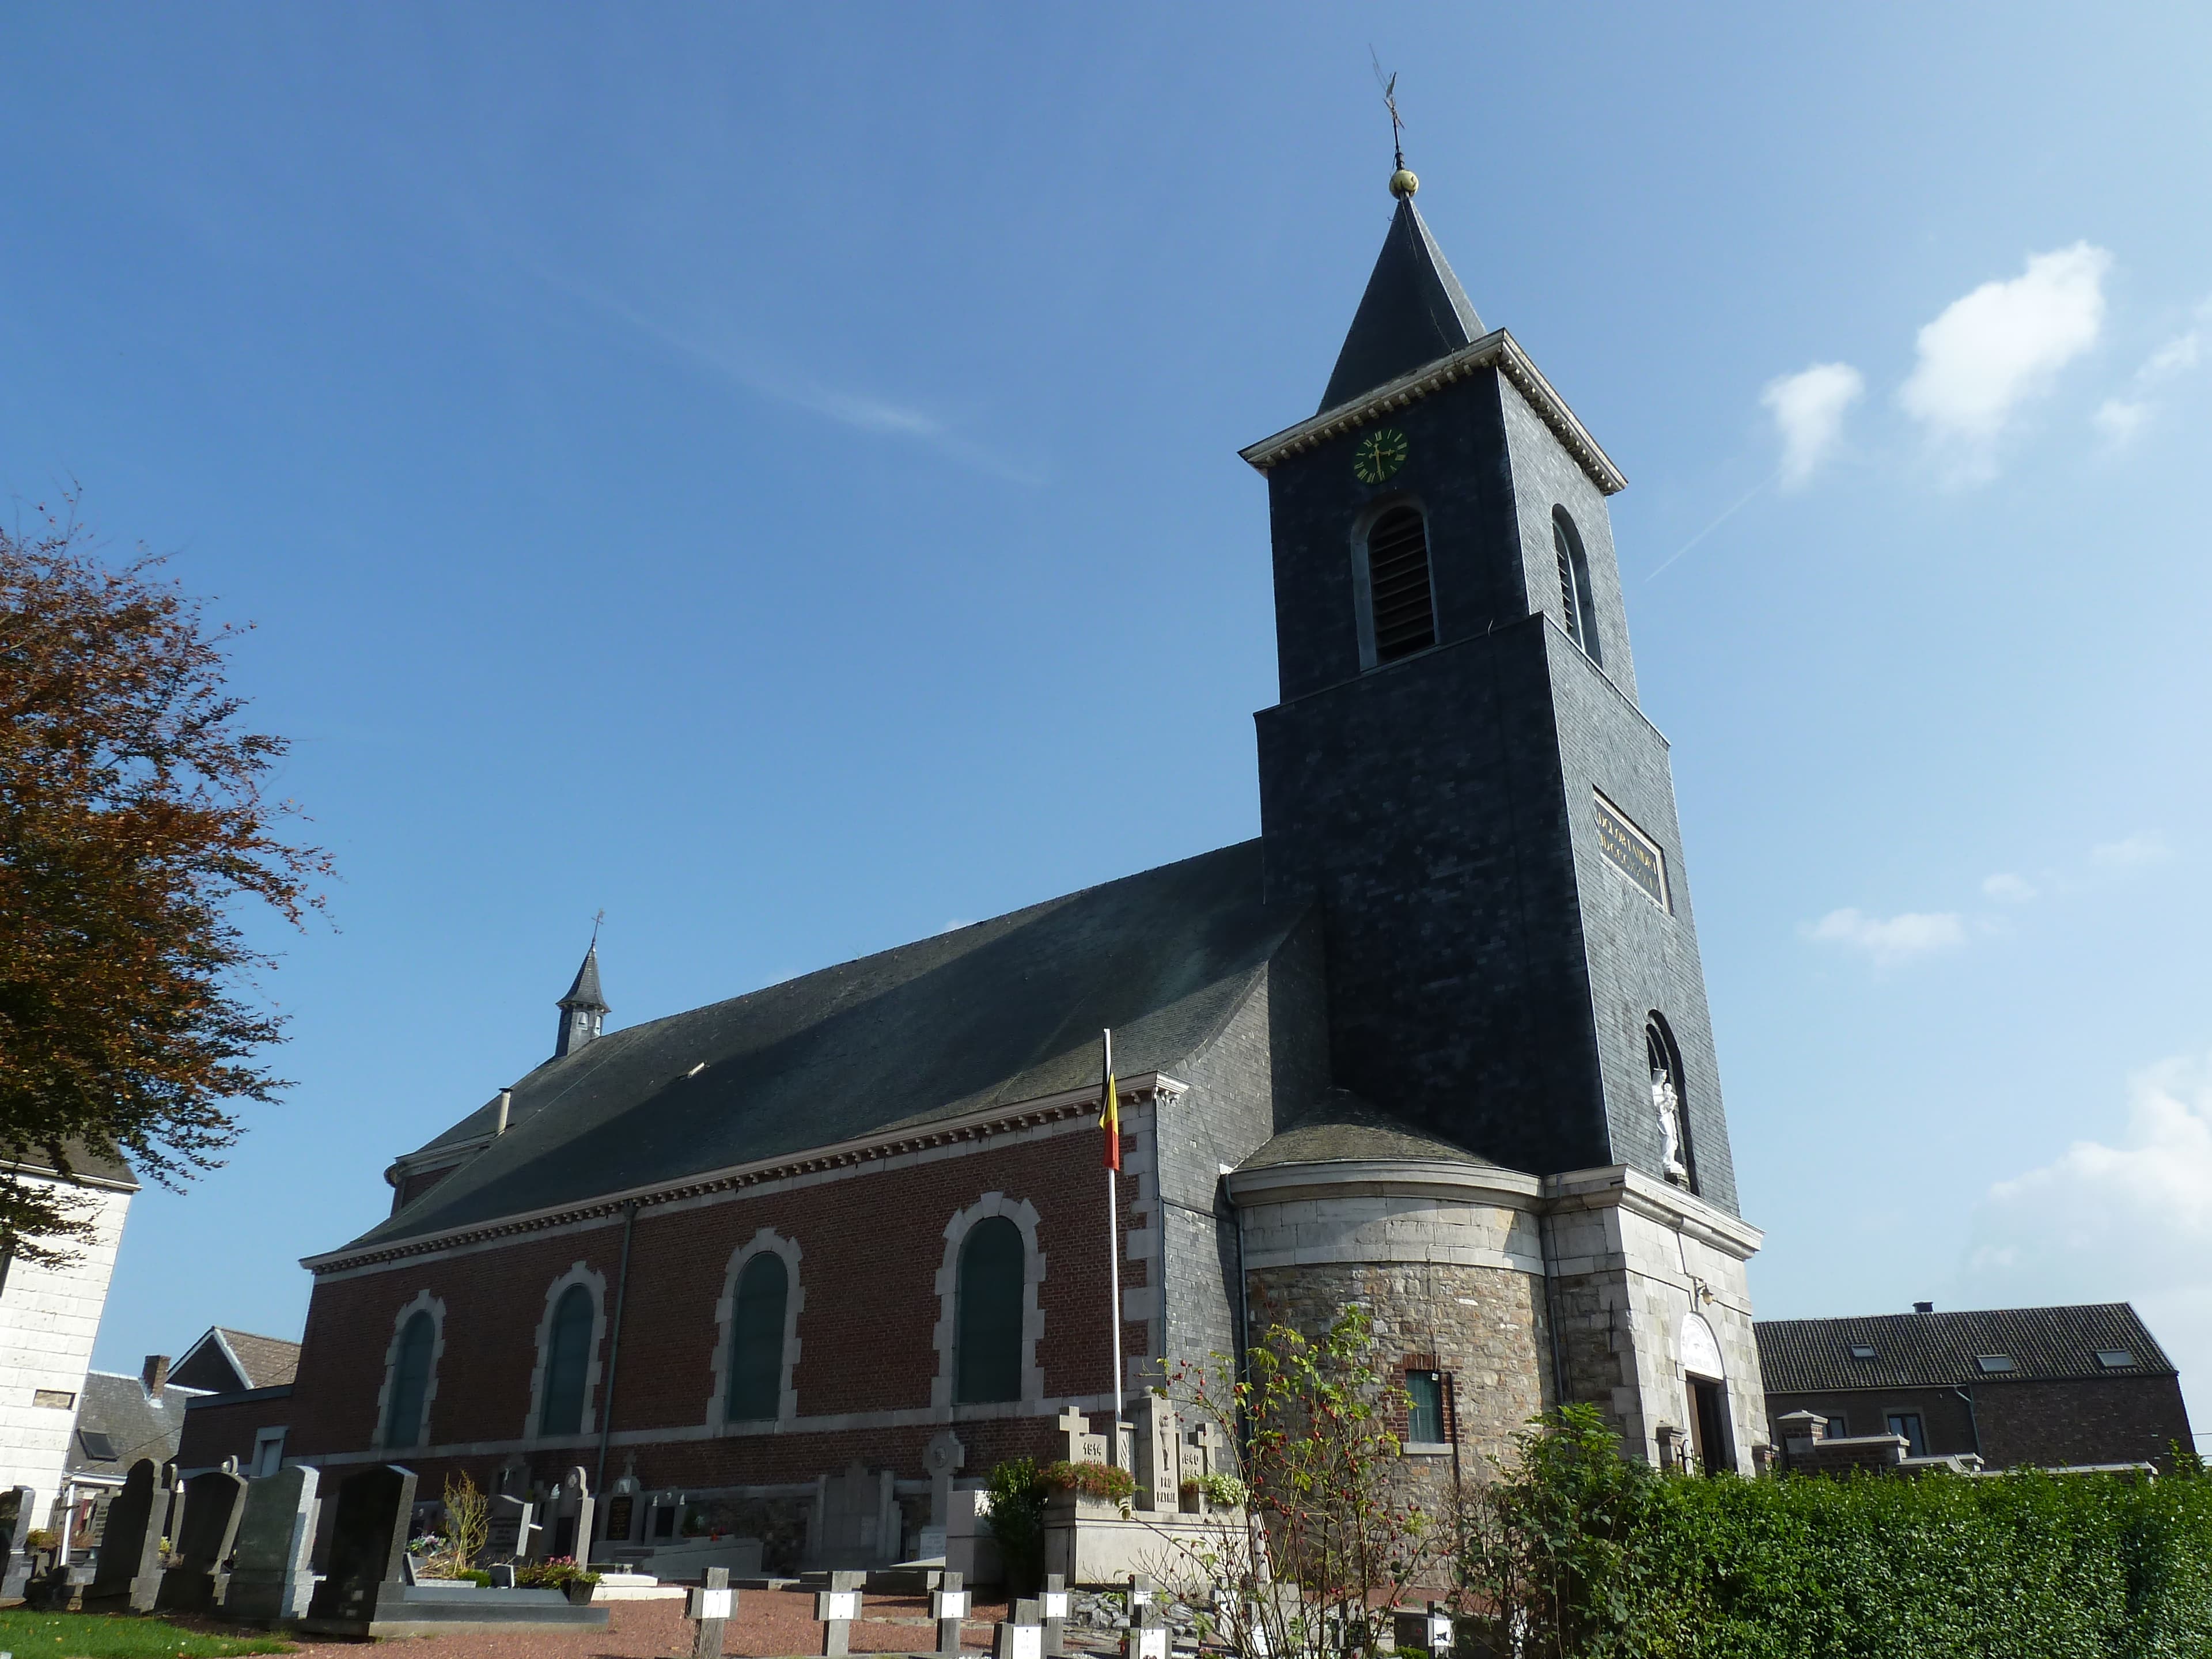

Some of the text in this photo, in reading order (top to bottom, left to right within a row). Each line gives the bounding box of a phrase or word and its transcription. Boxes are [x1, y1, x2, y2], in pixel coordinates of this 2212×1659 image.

[1083, 1442, 1101, 1456] 1914
[1181, 1453, 1199, 1465] 1940
[1161, 1476, 1172, 1488] PRO
